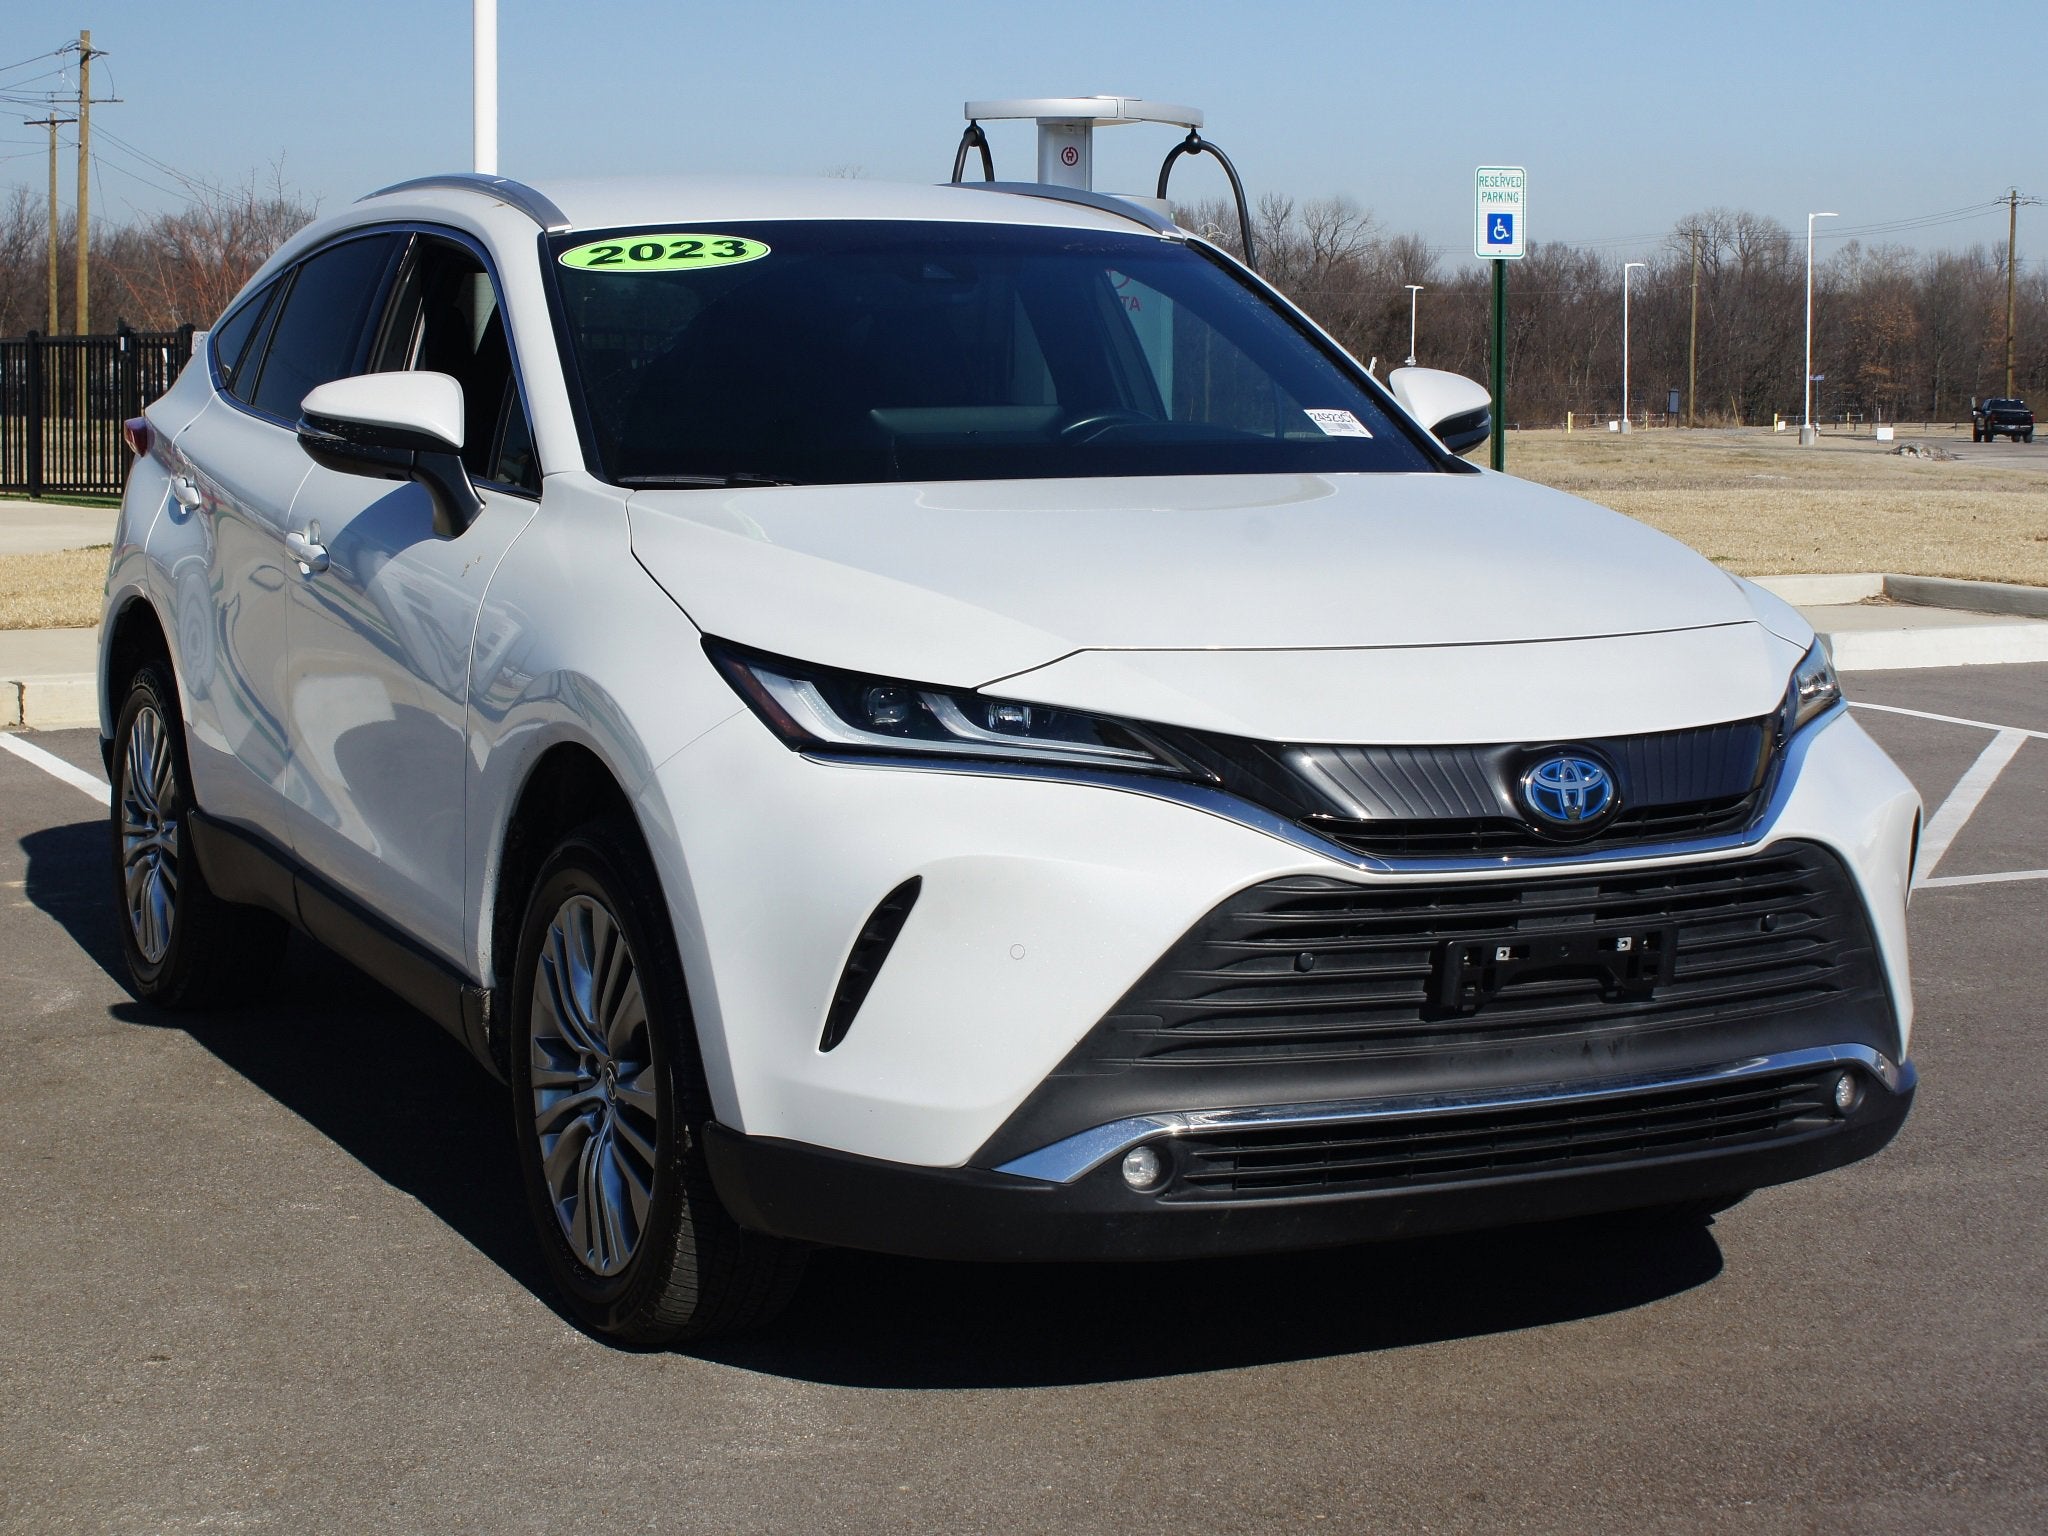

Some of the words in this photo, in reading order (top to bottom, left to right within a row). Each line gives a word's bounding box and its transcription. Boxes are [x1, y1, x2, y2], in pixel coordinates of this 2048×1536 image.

[1479, 176, 1522, 188] RESERVED
[1481, 191, 1519, 203] PARKING
[587, 240, 749, 266] 2023
